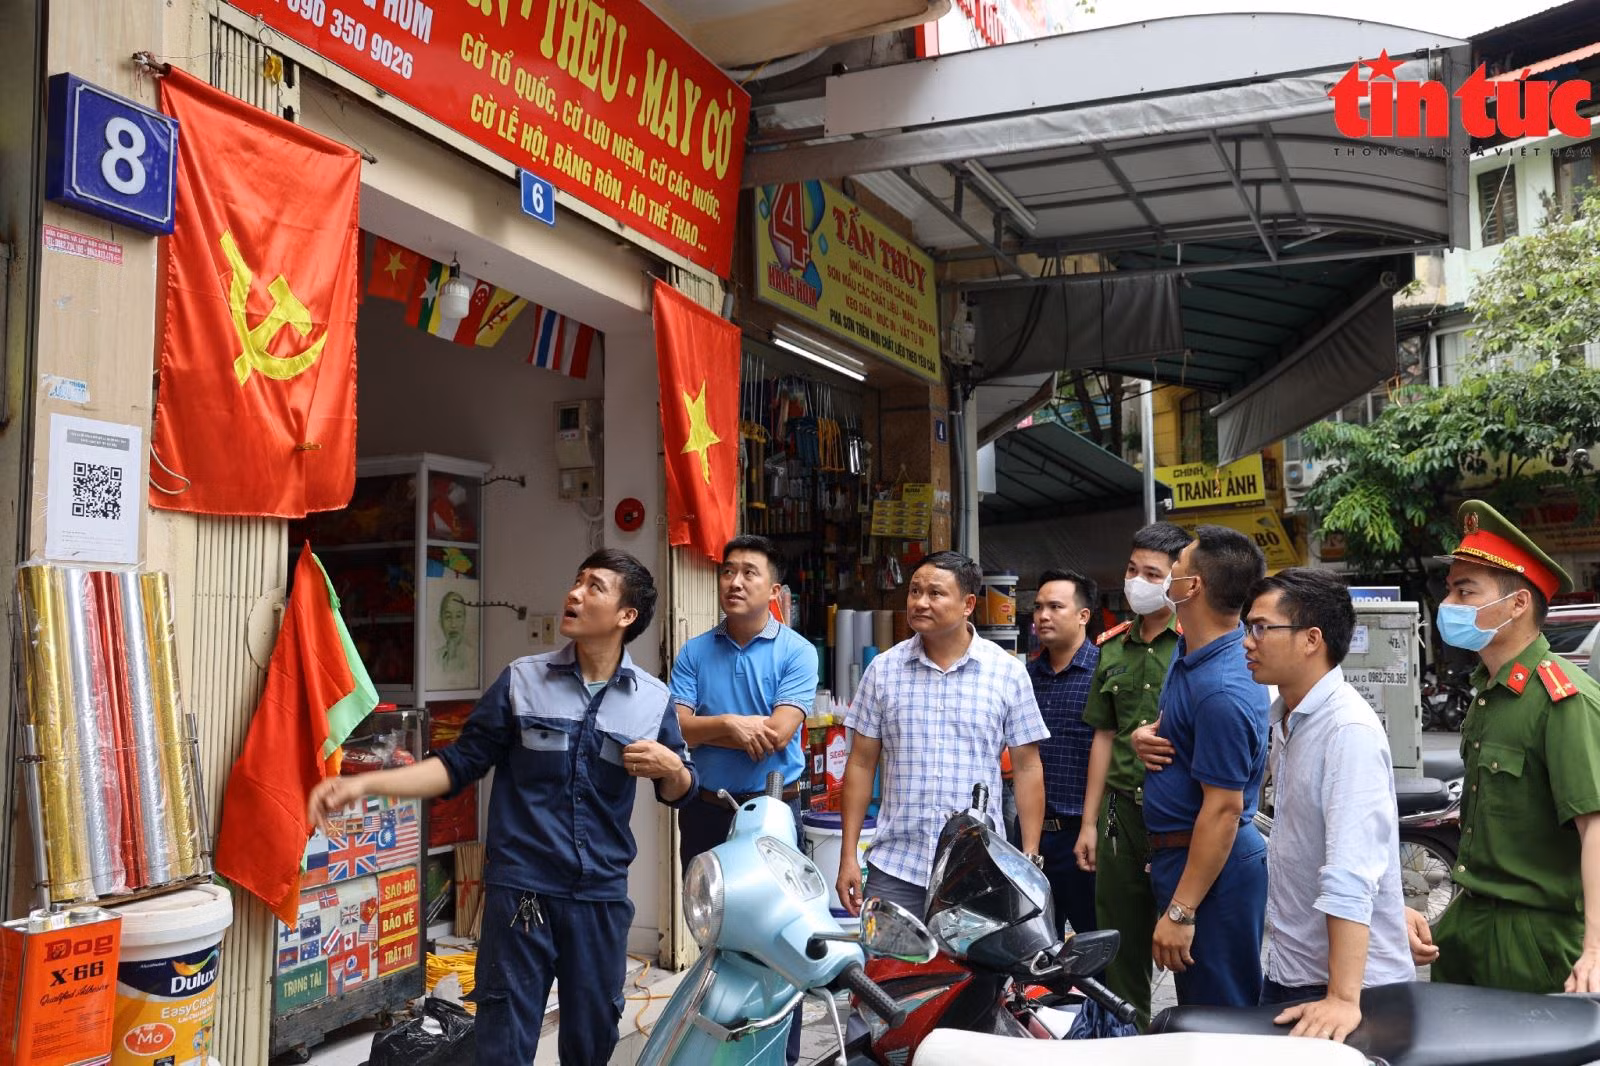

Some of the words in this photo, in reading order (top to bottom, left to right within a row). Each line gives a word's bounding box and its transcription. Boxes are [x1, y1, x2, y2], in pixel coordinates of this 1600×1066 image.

[329, 8, 366, 51] 350
[370, 33, 414, 80] 9026
[460, 33, 488, 70] CỜ
[490, 49, 514, 86] TỔ
[514, 67, 558, 122] QUỐC,
[563, 99, 583, 133] CỜ
[583, 116, 609, 150] LƯU
[611, 131, 647, 178] NIỆM,
[649, 157, 667, 189] CỜ
[667, 168, 690, 199] CÁC
[692, 187, 721, 223] NƯỚC,
[637, 48, 702, 156] MAY
[701, 88, 736, 180] CỜ
[101, 116, 146, 195] 8
[470, 93, 497, 130] CỜ
[497, 104, 519, 144] LỄ
[520, 122, 551, 166] HỘI,
[553, 142, 592, 188] BĂNG
[594, 169, 626, 209] RÔN,
[628, 184, 646, 217] ÁO
[648, 197, 671, 231] THỂ
[531, 182, 545, 214] 6
[771, 181, 811, 272] 4
[857, 282, 870, 299] CÁC
[871, 289, 886, 308] CHẤT
[829, 308, 842, 327] PHA
[843, 315, 855, 334] SƠN
[1176, 479, 1222, 501] TRANH
[1226, 470, 1257, 497] ẢNH
[384, 881, 402, 900] SAO
[403, 873, 416, 894] ĐỎ
[382, 908, 401, 932] BẢO
[403, 906, 415, 927] VỆ
[43, 934, 113, 963] Dog
[384, 945, 402, 966] TRẬT
[403, 940, 414, 960] TỰ
[50, 960, 104, 987] X-66
[170, 968, 215, 994] Dulux
[283, 977, 308, 998] TRỌNG
